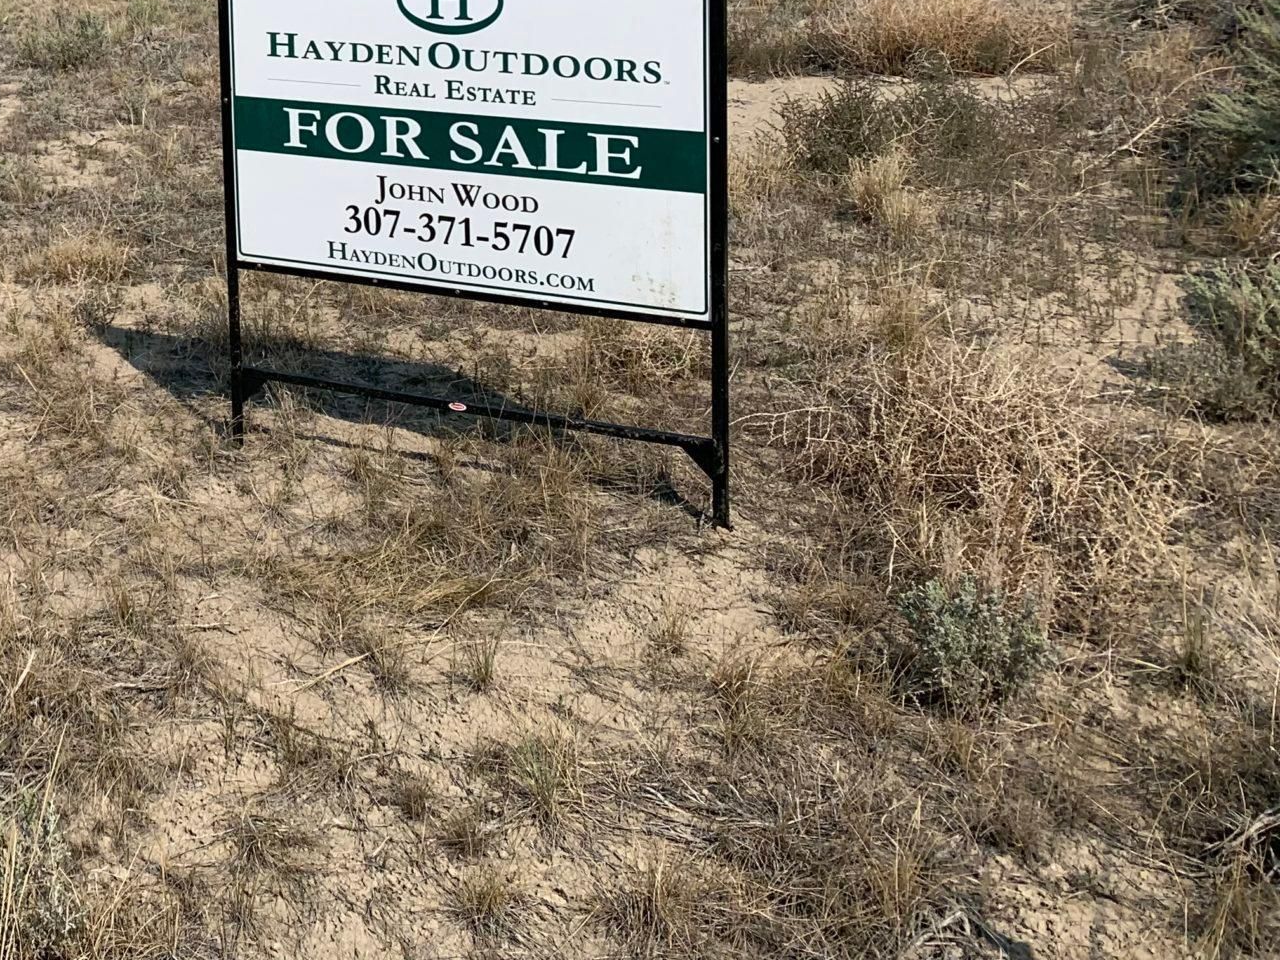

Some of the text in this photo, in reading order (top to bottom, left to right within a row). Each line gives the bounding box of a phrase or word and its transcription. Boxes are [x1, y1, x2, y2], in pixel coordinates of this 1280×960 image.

[374, 74, 537, 106] REAL ESTATE
[282, 107, 642, 180] FOR SALE
[374, 174, 539, 214] JOHN WOOD
[343, 204, 576, 259] 307-371-5707
